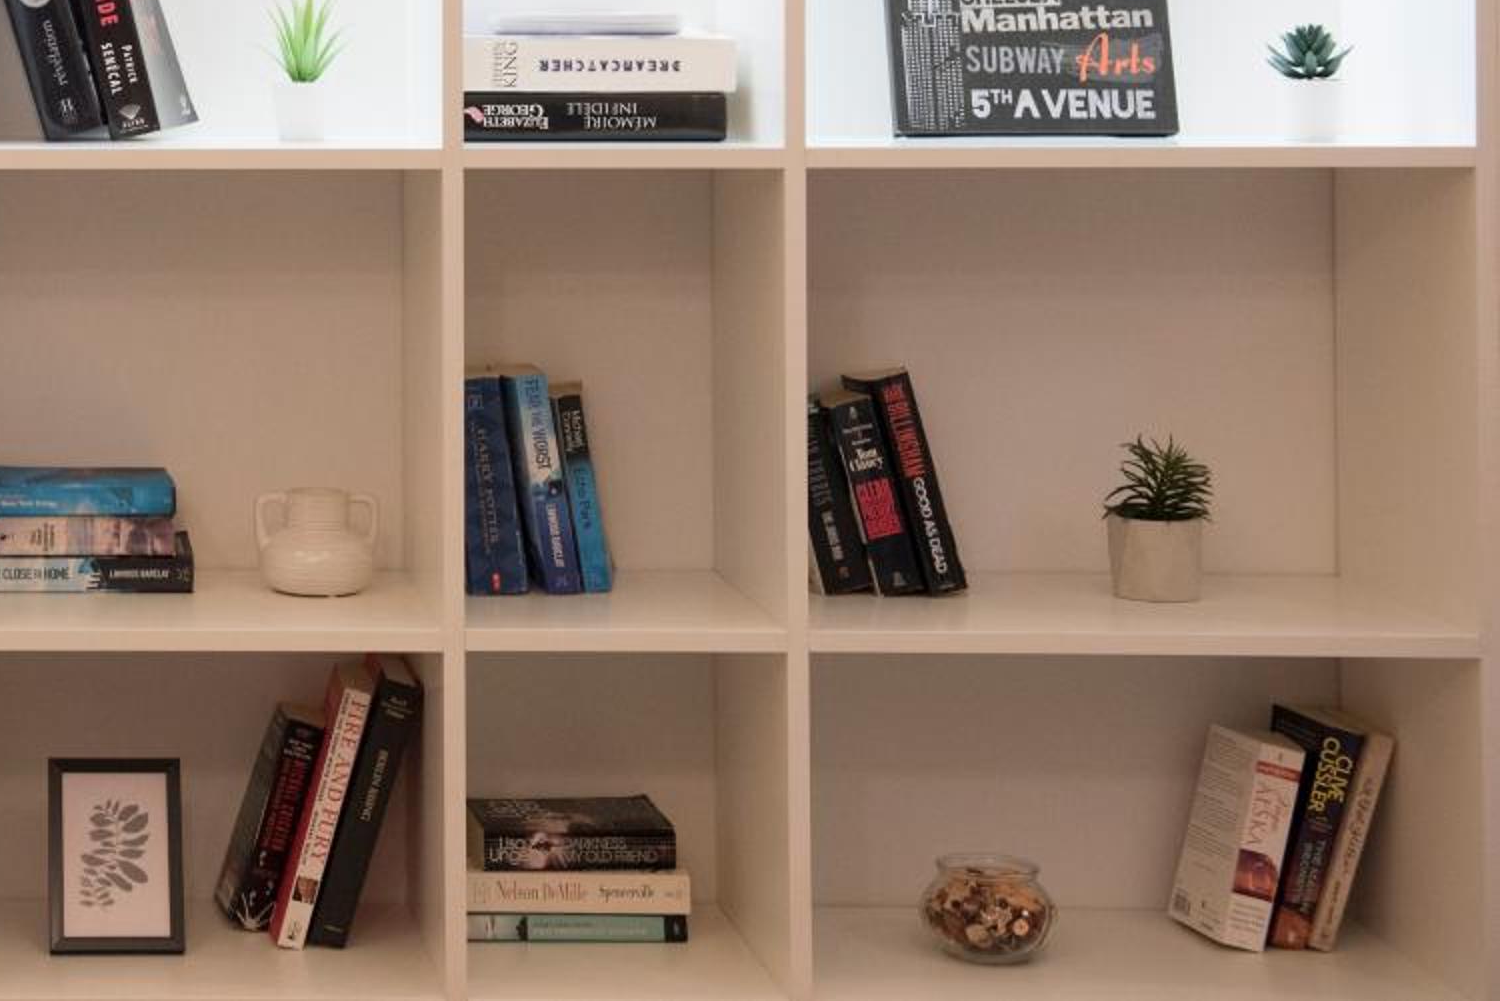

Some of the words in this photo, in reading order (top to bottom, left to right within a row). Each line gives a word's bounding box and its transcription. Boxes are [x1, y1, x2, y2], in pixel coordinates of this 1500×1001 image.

[961, 5, 1153, 33] Manhattan
[121, 44, 138, 83] PATRICK
[504, 41, 518, 88] KING
[966, 46, 1065, 74] SUBWAY
[1076, 33, 1156, 82] Arts
[483, 103, 545, 118] GEORGE
[483, 115, 548, 130] ELIZABETH
[1014, 88, 1156, 119] AVENUE
[533, 428, 551, 470] WORST
[913, 477, 932, 518] GOOD
[924, 519, 940, 539] AS
[2, 566, 32, 580] CLOSE
[44, 566, 69, 580] HOME
[929, 538, 948, 575] DEAD
[342, 699, 366, 748] FIRE
[328, 753, 350, 800] AND
[1307, 737, 1341, 812] CUSSLER
[1327, 756, 1354, 804] CLIVE
[316, 806, 338, 862] FURY
[583, 850, 611, 863] OLD
[613, 850, 659, 863] FRIEND
[496, 880, 538, 901] Nelson
[542, 881, 588, 901] DeMille
